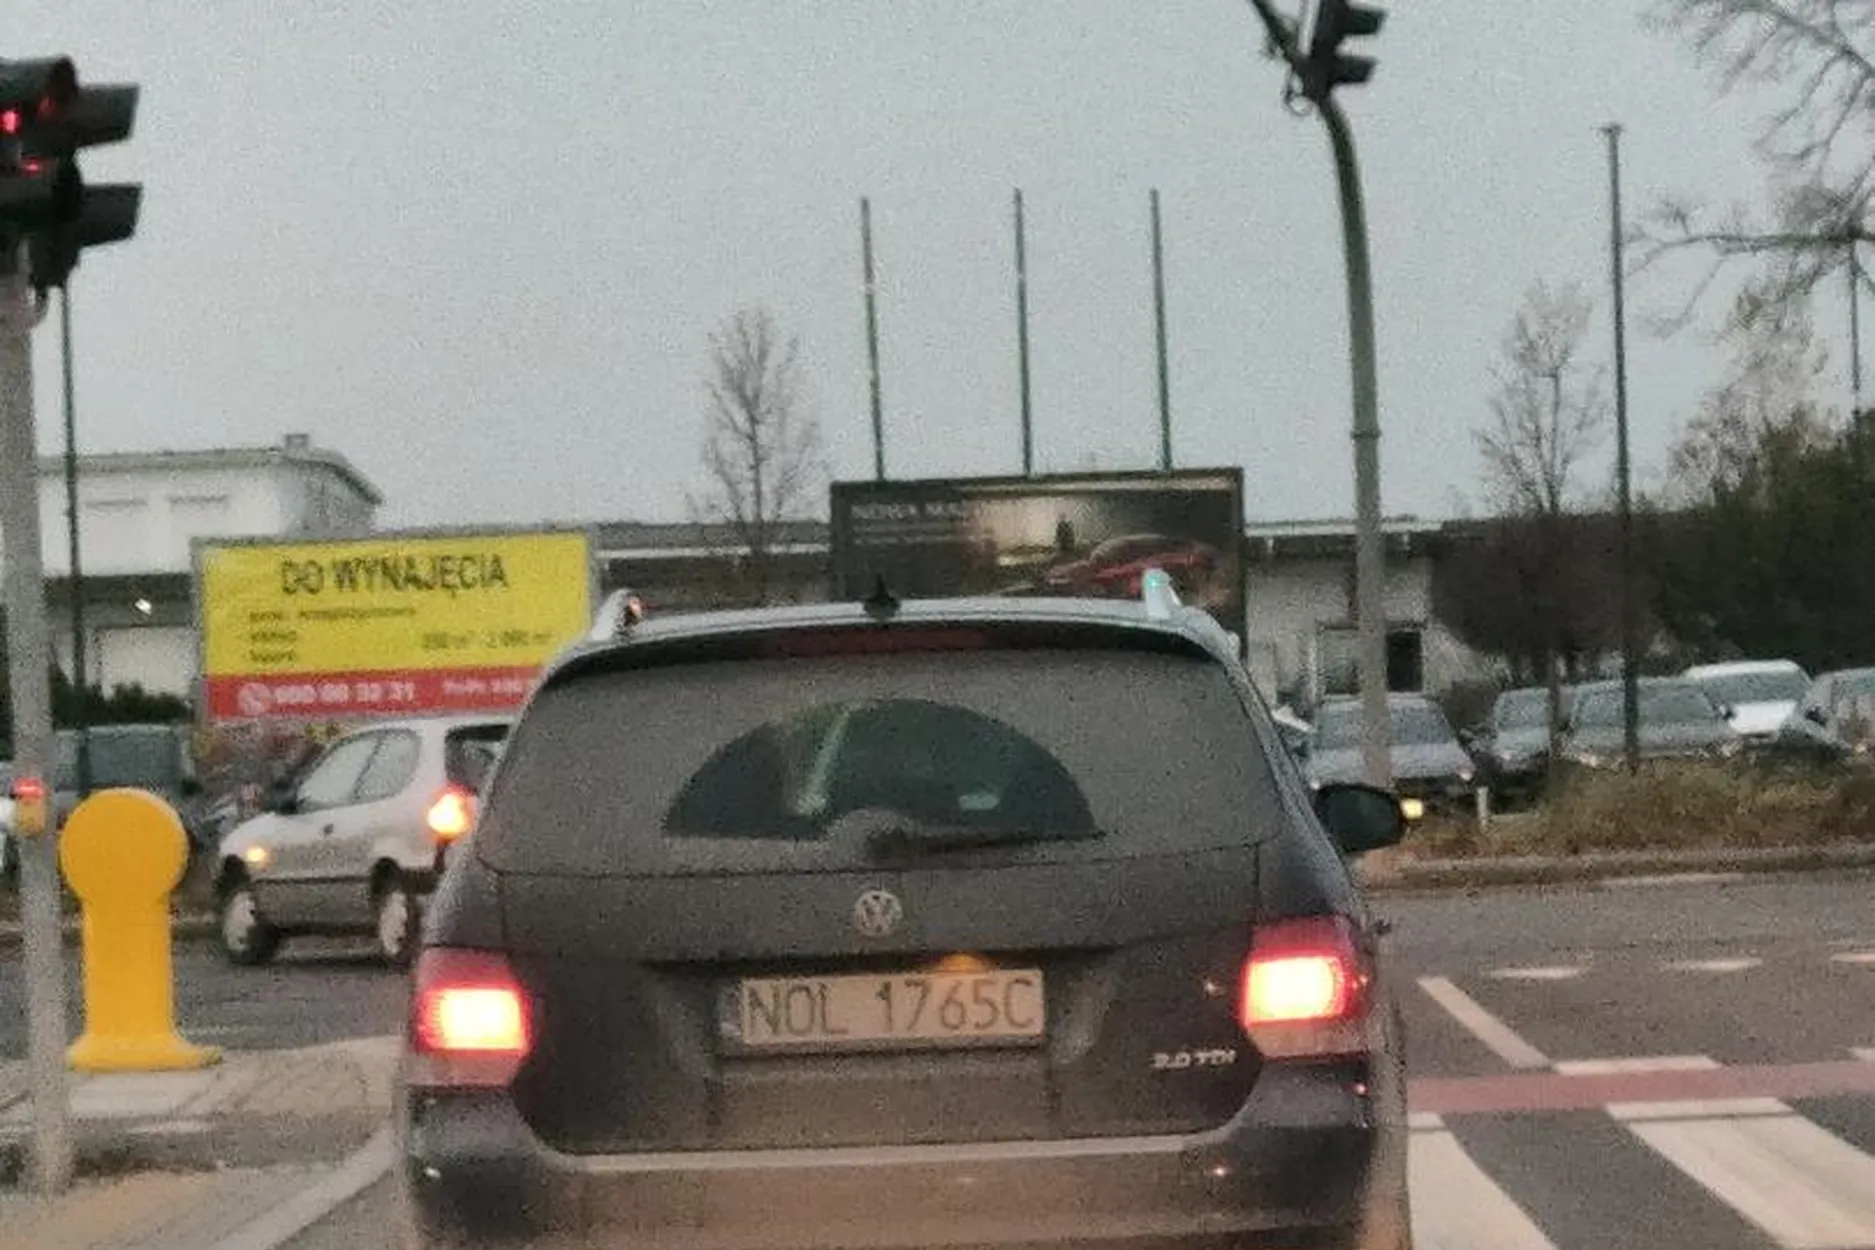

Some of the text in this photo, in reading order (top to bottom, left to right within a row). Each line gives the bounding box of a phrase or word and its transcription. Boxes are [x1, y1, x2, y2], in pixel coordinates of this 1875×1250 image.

[282, 553, 509, 599] DO WYNAJĘCIA
[748, 977, 1034, 1036] NOL 1765C
